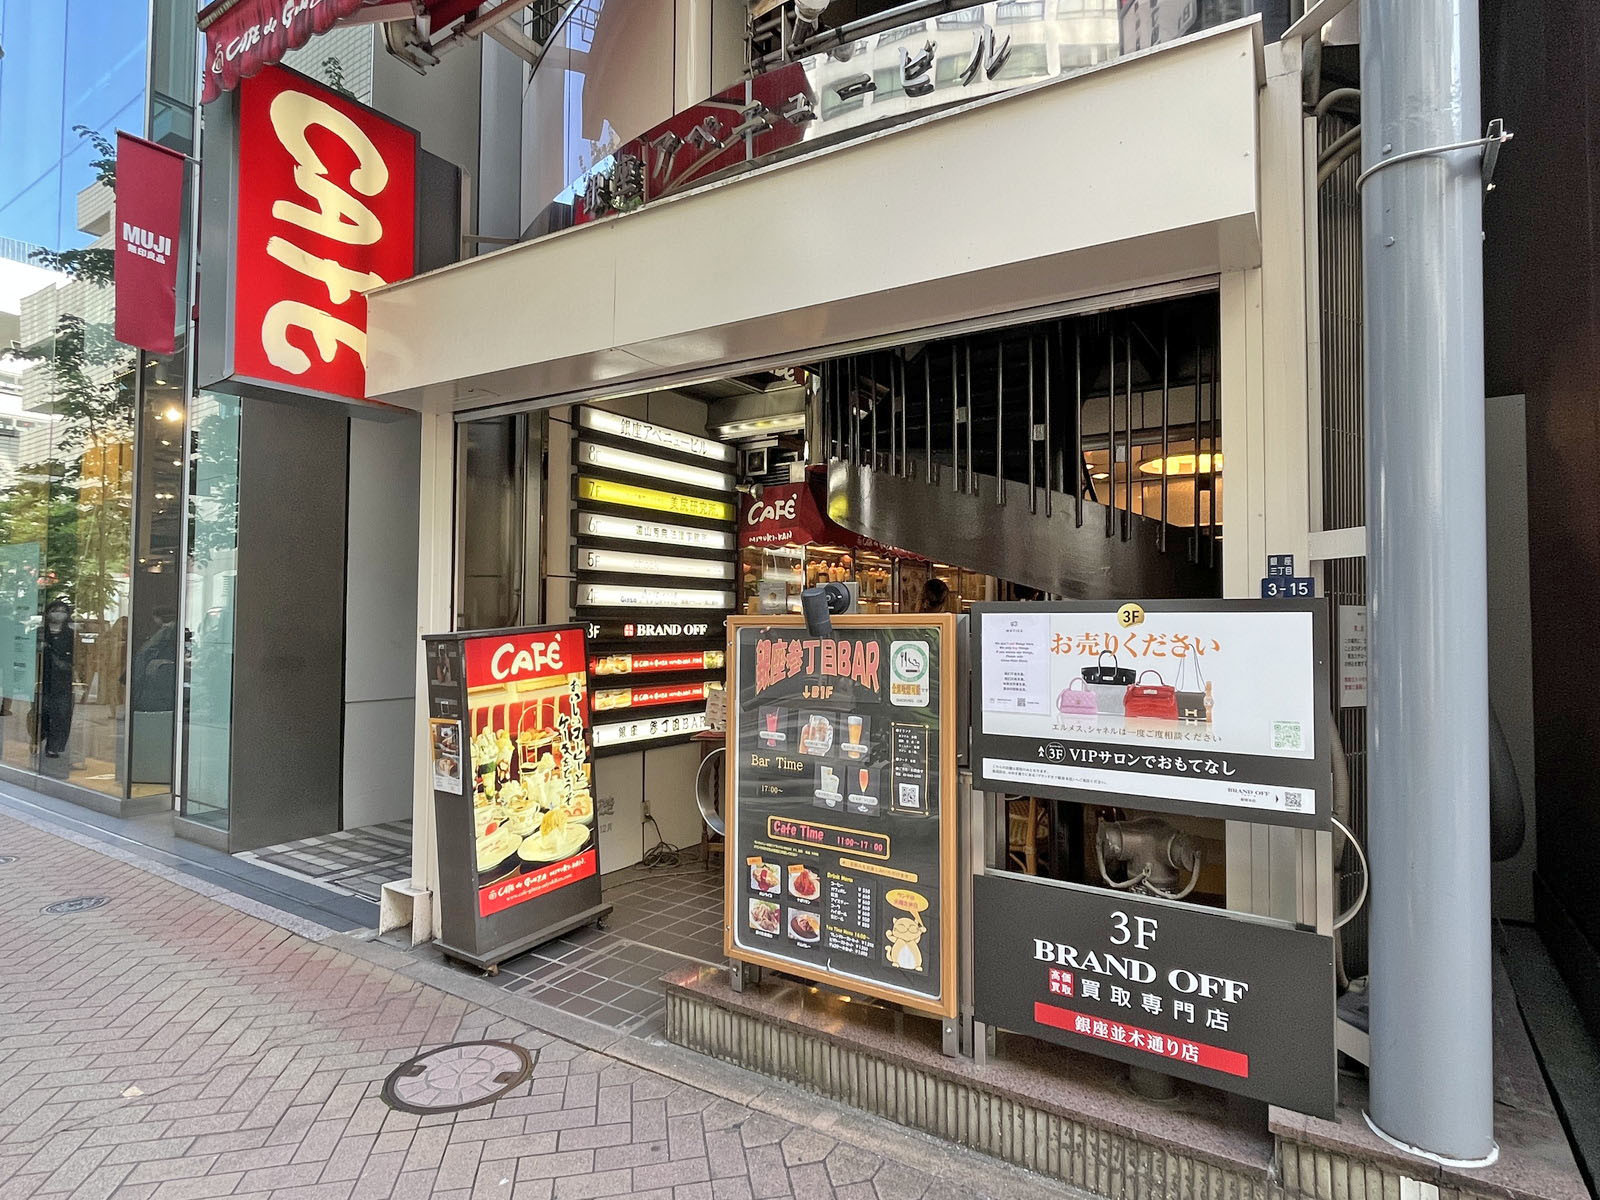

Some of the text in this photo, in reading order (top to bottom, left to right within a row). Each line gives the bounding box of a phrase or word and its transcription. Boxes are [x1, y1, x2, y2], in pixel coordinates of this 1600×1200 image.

[123, 222, 172, 257] MUJI
[620, 418, 708, 455] 銀座アベニュービル
[588, 481, 602, 498] 7F
[747, 493, 798, 526] CAFÉ
[586, 551, 601, 568] 5F
[1269, 566, 1293, 576] 三丁目
[1267, 582, 1309, 596] 3-15
[636, 624, 682, 637] BRAND
[683, 623, 708, 636] OFF
[1122, 609, 1140, 624] 3F
[491, 634, 564, 680] CAFÉ
[1050, 631, 1221, 658] お売りください
[756, 639, 880, 696] 銀座参丁目BAR
[751, 754, 803, 771] Bar Time
[1049, 748, 1063, 760] 3F
[1069, 748, 1236, 776] VIPサロンでおもてなし
[773, 820, 797, 836] Cafe
[800, 825, 824, 841] Time
[1109, 911, 1158, 950] 3F
[1033, 938, 1249, 1004] BRAND OFF
[1081, 978, 1230, 1032] 買取専門店
[1075, 1015, 1200, 1063] 銀座並木通り店
